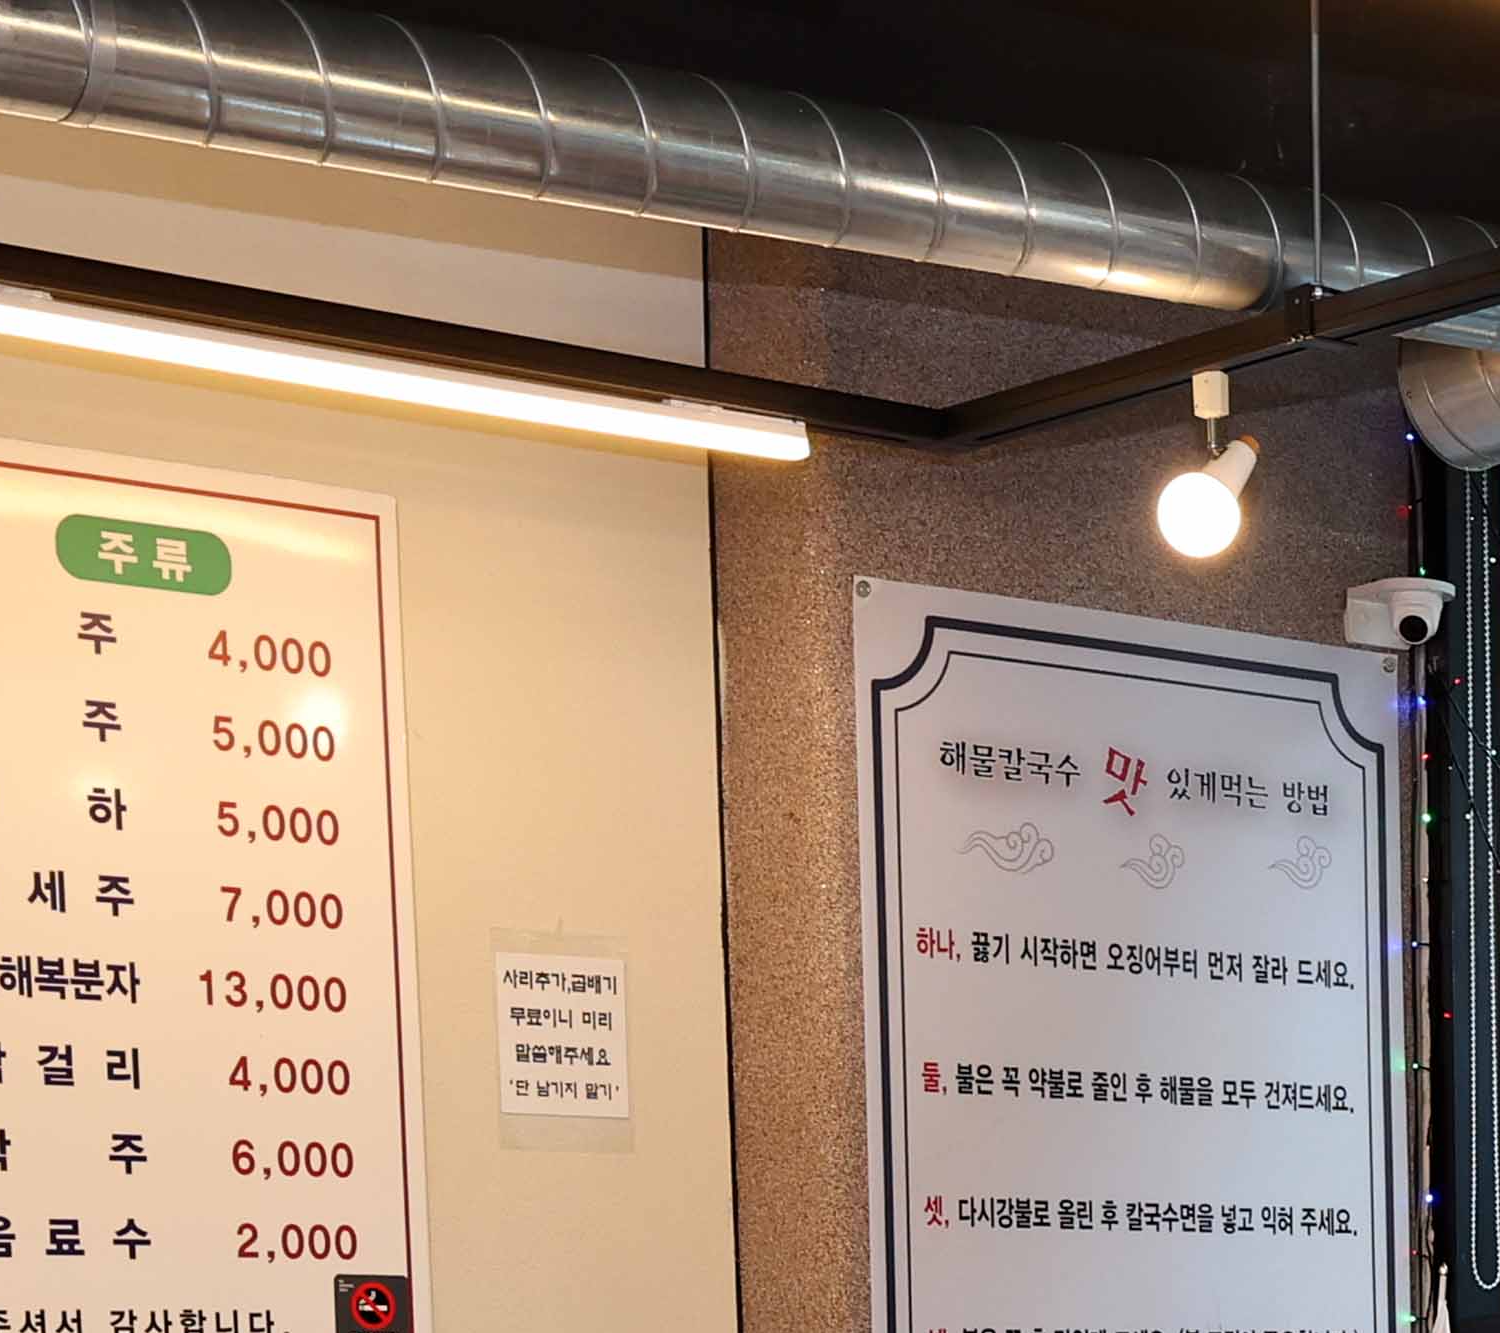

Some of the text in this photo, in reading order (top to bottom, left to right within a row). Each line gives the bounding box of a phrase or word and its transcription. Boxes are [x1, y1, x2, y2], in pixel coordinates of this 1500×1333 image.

[99, 531, 192, 583] 주류
[208, 630, 332, 678] 4,000
[212, 716, 336, 762] 5,000
[938, 740, 1082, 788] 해물칼국수
[1102, 746, 1148, 816] 맛
[1282, 781, 1330, 816] 방법
[217, 800, 340, 846] 5,000
[220, 885, 345, 931] 7,000
[971, 931, 1012, 966] 끓기
[1020, 935, 1098, 973] 시작하면
[1106, 942, 1200, 980] 오징어부터
[1207, 951, 1245, 983] 먼저
[1252, 955, 1290, 986] 잘라
[1296, 958, 1356, 990] 드세요.
[199, 970, 348, 1014] 13,000
[510, 1006, 612, 1030] 무료이니 미리
[229, 1056, 351, 1096] 4,000
[536, 1080, 578, 1098] 남기지
[956, 1063, 994, 1096] 불은
[1001, 1066, 1021, 1096] 꼭
[1135, 1073, 1154, 1104] 후
[1160, 1074, 1214, 1106] 해물을
[1221, 1079, 1256, 1108] 모두
[232, 1140, 355, 1178] 6,000
[958, 1198, 1051, 1229] 다시강불로
[1057, 1201, 1093, 1231] 올린
[1100, 1202, 1119, 1232] 후
[1125, 1202, 1214, 1234] 칼국수면을
[1220, 1205, 1253, 1234] 넣고
[1300, 1208, 1358, 1237] 주세요.
[237, 1225, 358, 1261] 2,000
